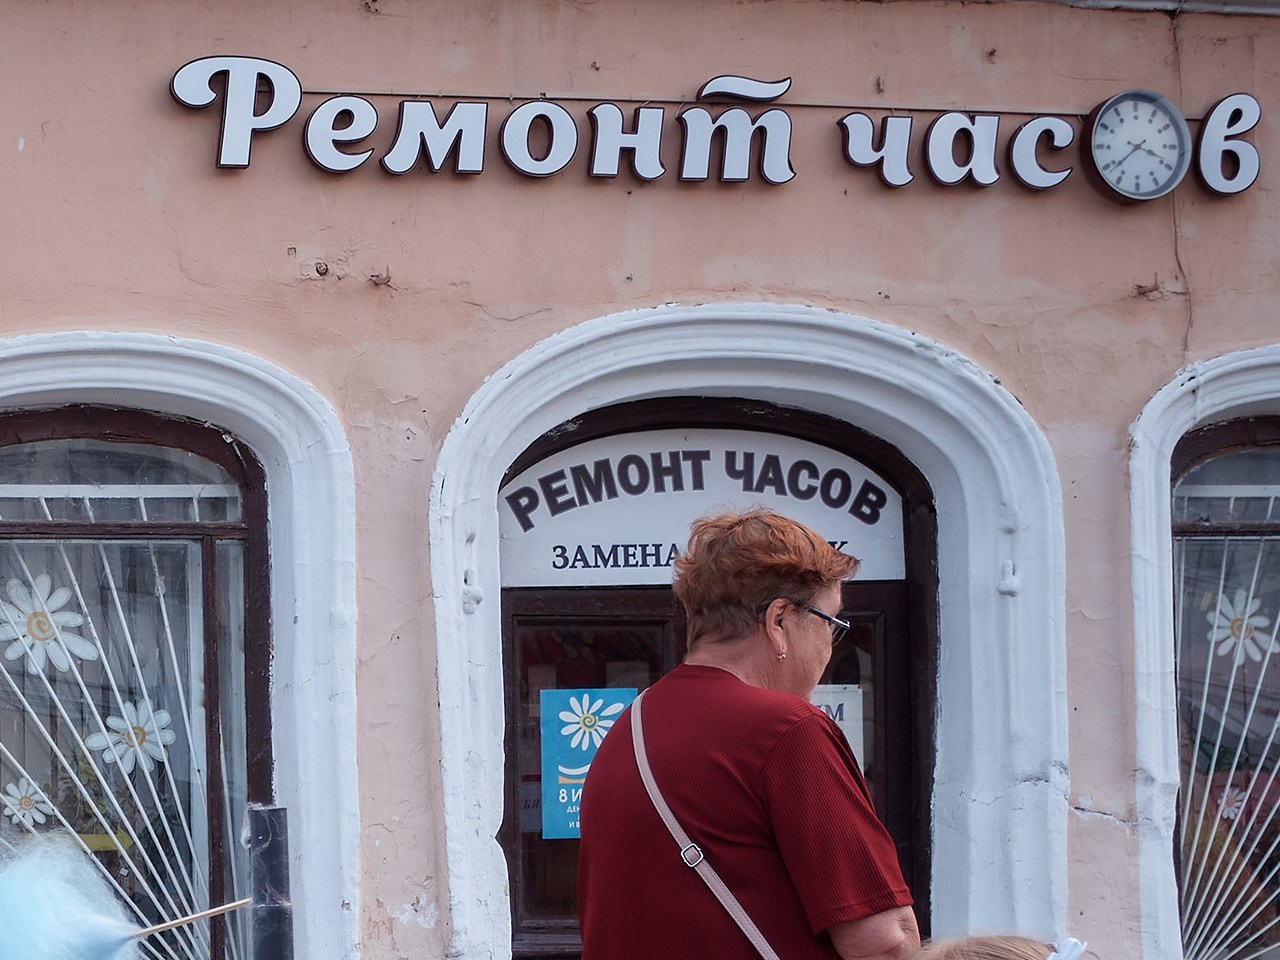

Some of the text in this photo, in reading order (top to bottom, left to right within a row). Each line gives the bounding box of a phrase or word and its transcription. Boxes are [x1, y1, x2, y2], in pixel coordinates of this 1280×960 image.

[168, 54, 797, 186] Ремонт
[505, 450, 888, 532] РЕМОНТ ЧАСОВ
